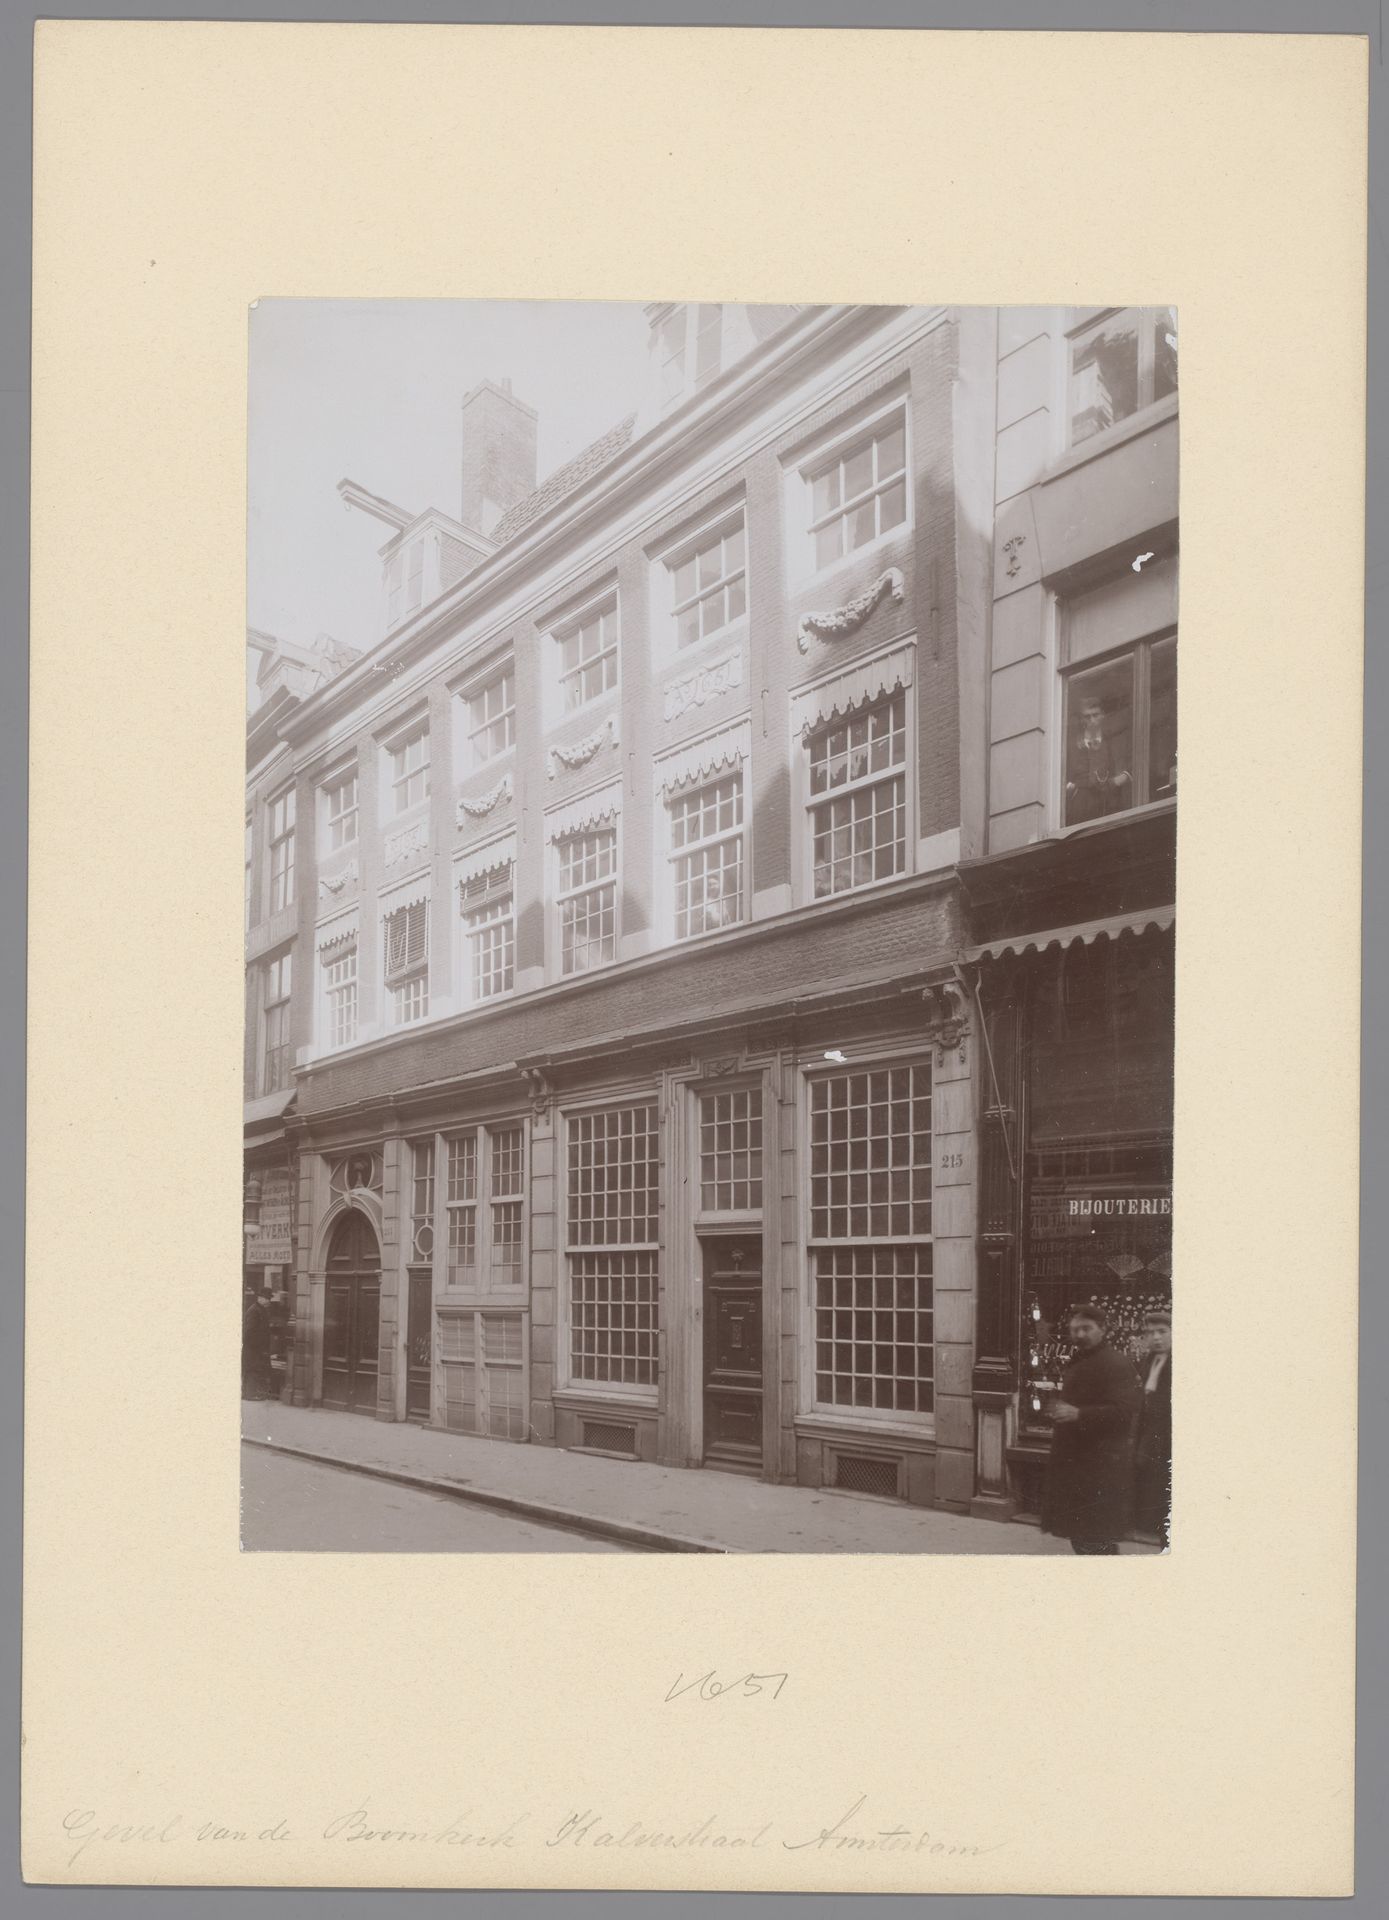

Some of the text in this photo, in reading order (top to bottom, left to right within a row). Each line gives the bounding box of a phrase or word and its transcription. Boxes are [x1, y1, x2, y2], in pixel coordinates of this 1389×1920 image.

[941, 1153, 963, 1168] 215
[1069, 1198, 1171, 1215] BIJOUTERIE
[664, 1669, 788, 1703] 1651
[195, 1820, 248, 1843] van
[257, 1817, 295, 1842] de
[782, 1794, 1005, 1857] Amsterdam
